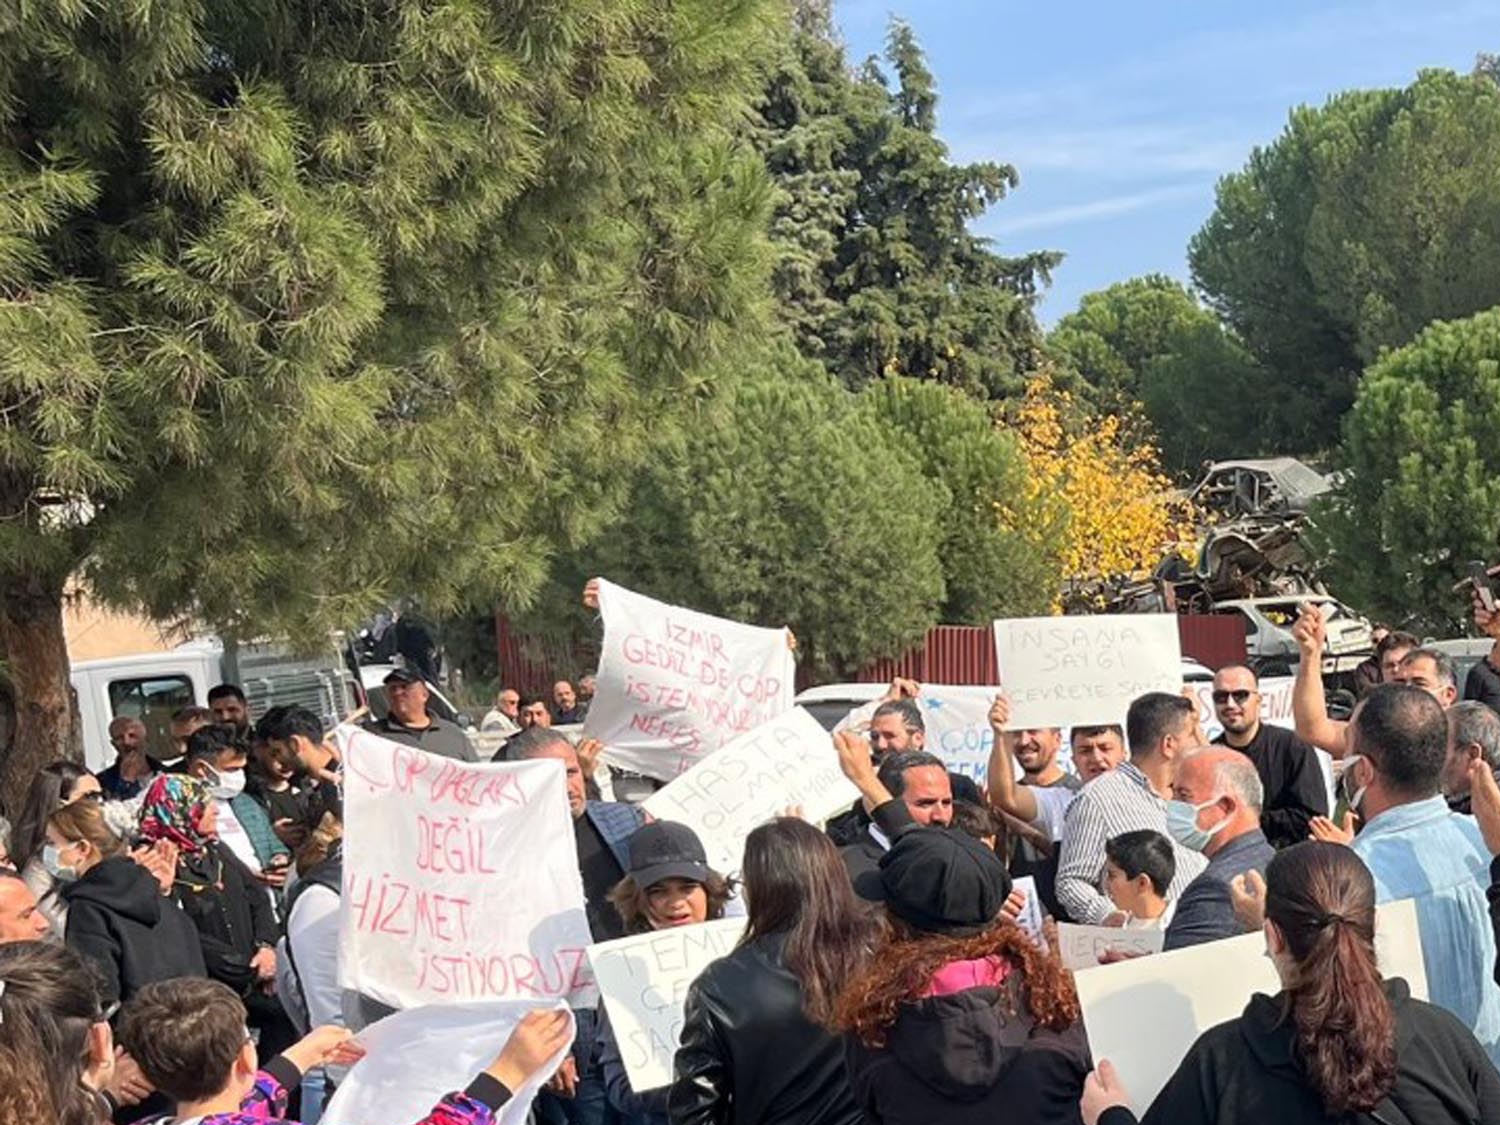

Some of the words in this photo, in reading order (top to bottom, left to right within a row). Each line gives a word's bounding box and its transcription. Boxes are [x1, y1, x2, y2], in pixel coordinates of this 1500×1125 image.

[670, 726, 802, 814] HASTA
[417, 815, 497, 874] DEĞİL
[350, 873, 470, 942] HİZMET
[417, 948, 595, 996] İSTİYORUZ
